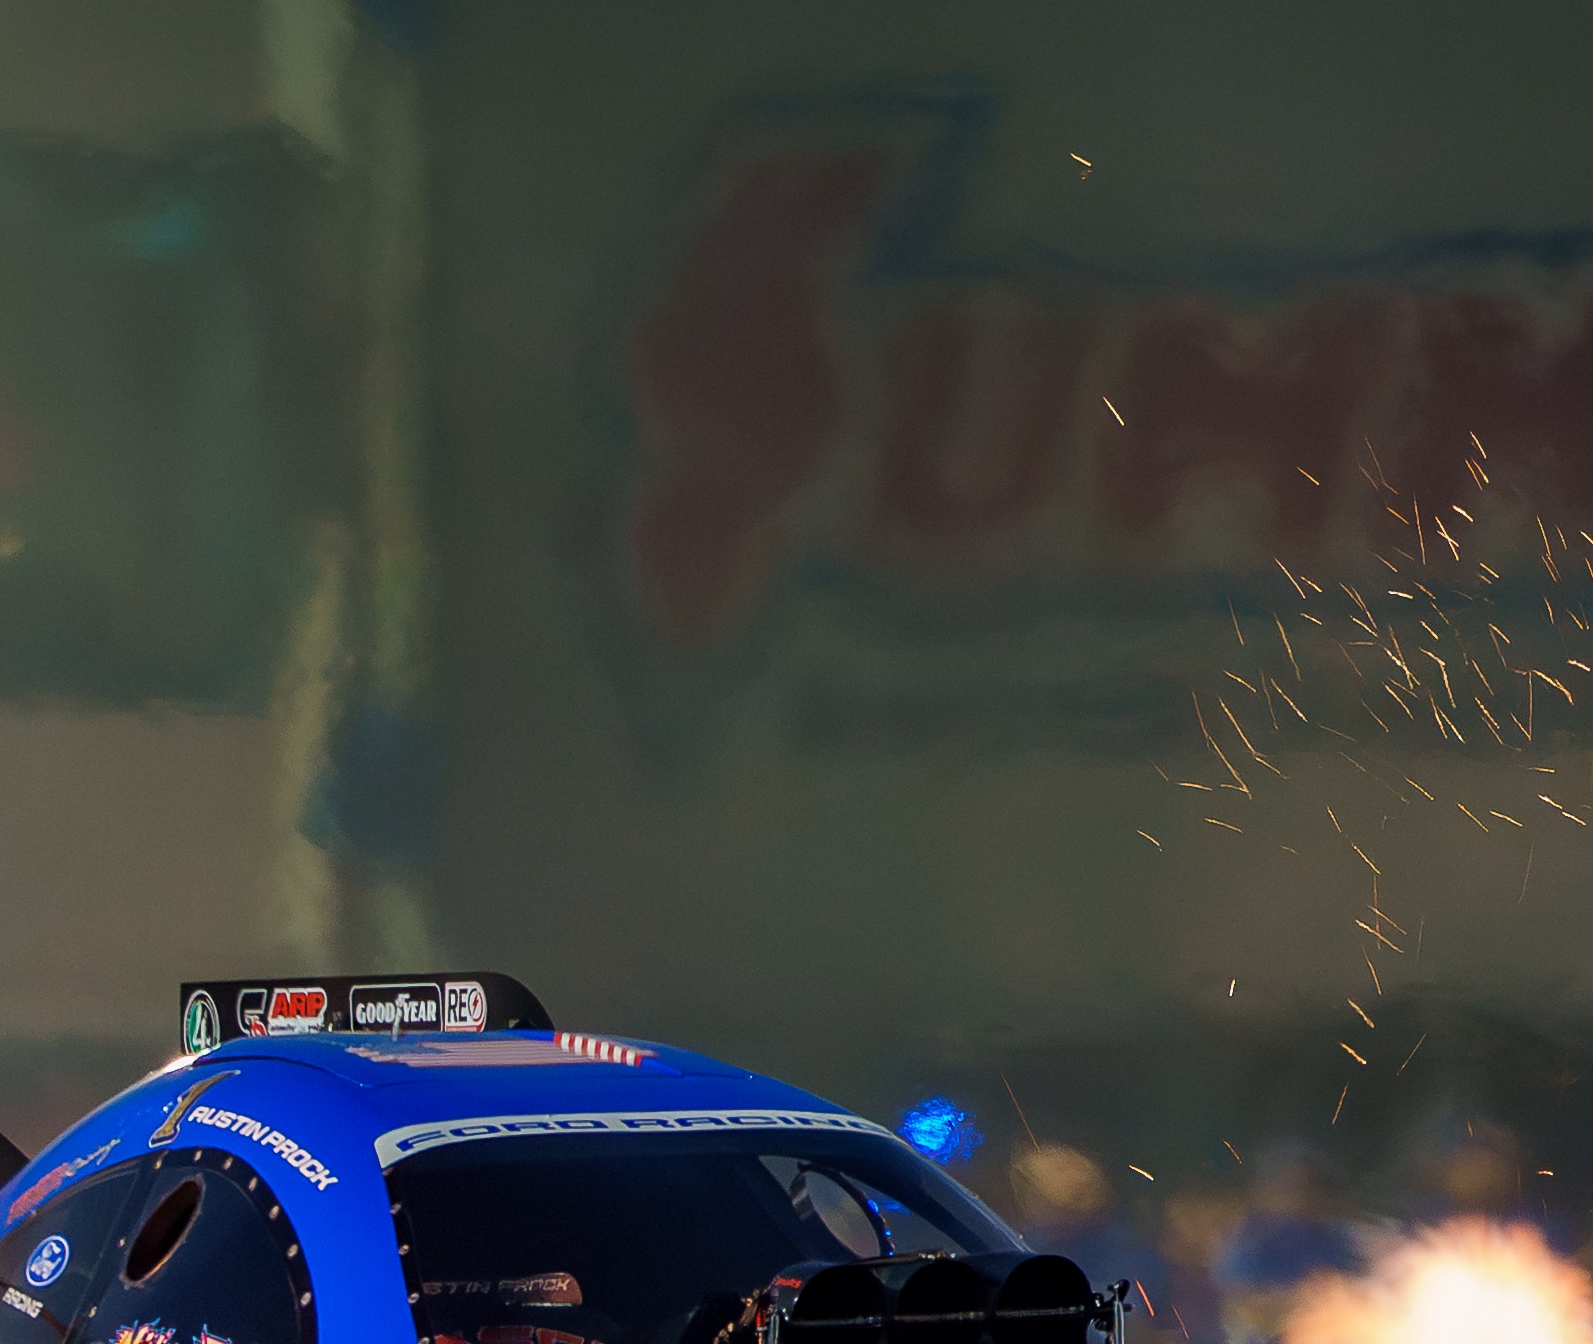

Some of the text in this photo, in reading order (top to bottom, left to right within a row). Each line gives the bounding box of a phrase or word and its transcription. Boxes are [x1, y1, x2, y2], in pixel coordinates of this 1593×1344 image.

[271, 992, 325, 1018] ARP
[355, 999, 437, 1025] GOODYEAR
[187, 1105, 339, 1191] AUSTIN PROCK
[395, 1115, 890, 1152] FORD RACING
